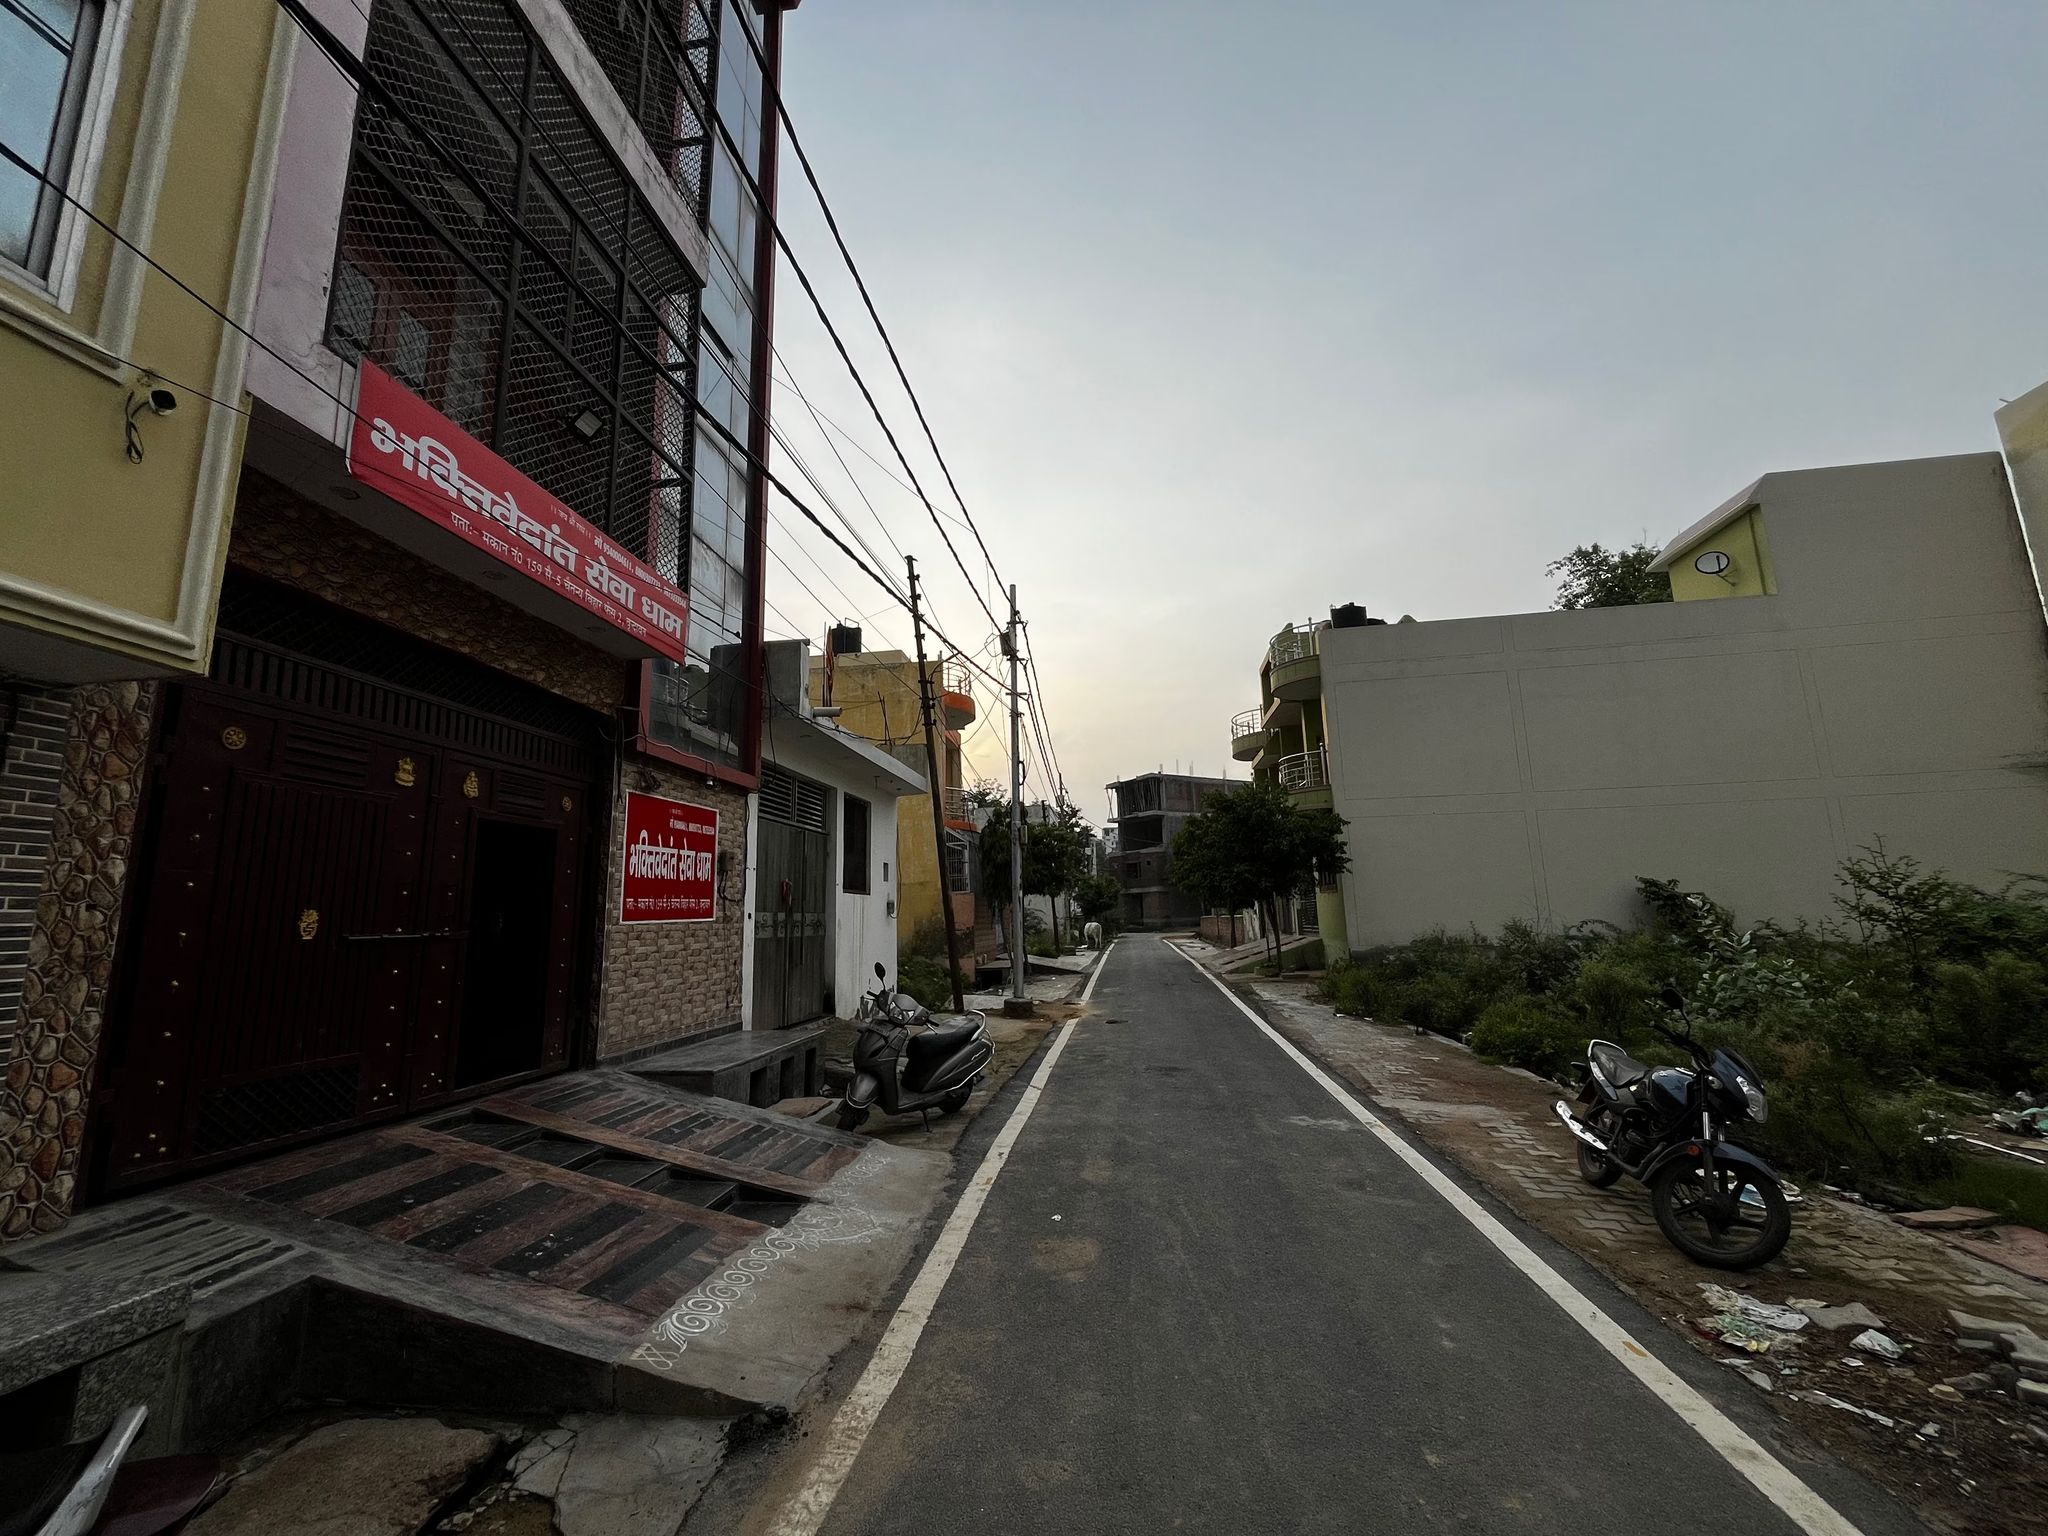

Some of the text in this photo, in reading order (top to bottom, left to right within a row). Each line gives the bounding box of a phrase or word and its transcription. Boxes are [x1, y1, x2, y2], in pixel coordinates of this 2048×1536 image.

[371, 417, 579, 572] भक्तिवेदांत
[585, 555, 637, 610] सेवा
[641, 594, 684, 639] धाम
[482, 530, 509, 556] मकान
[527, 557, 542, 575] 159
[585, 588, 603, 611] विहार
[629, 829, 712, 882] भक्तिवेदांत सेवा धाम
